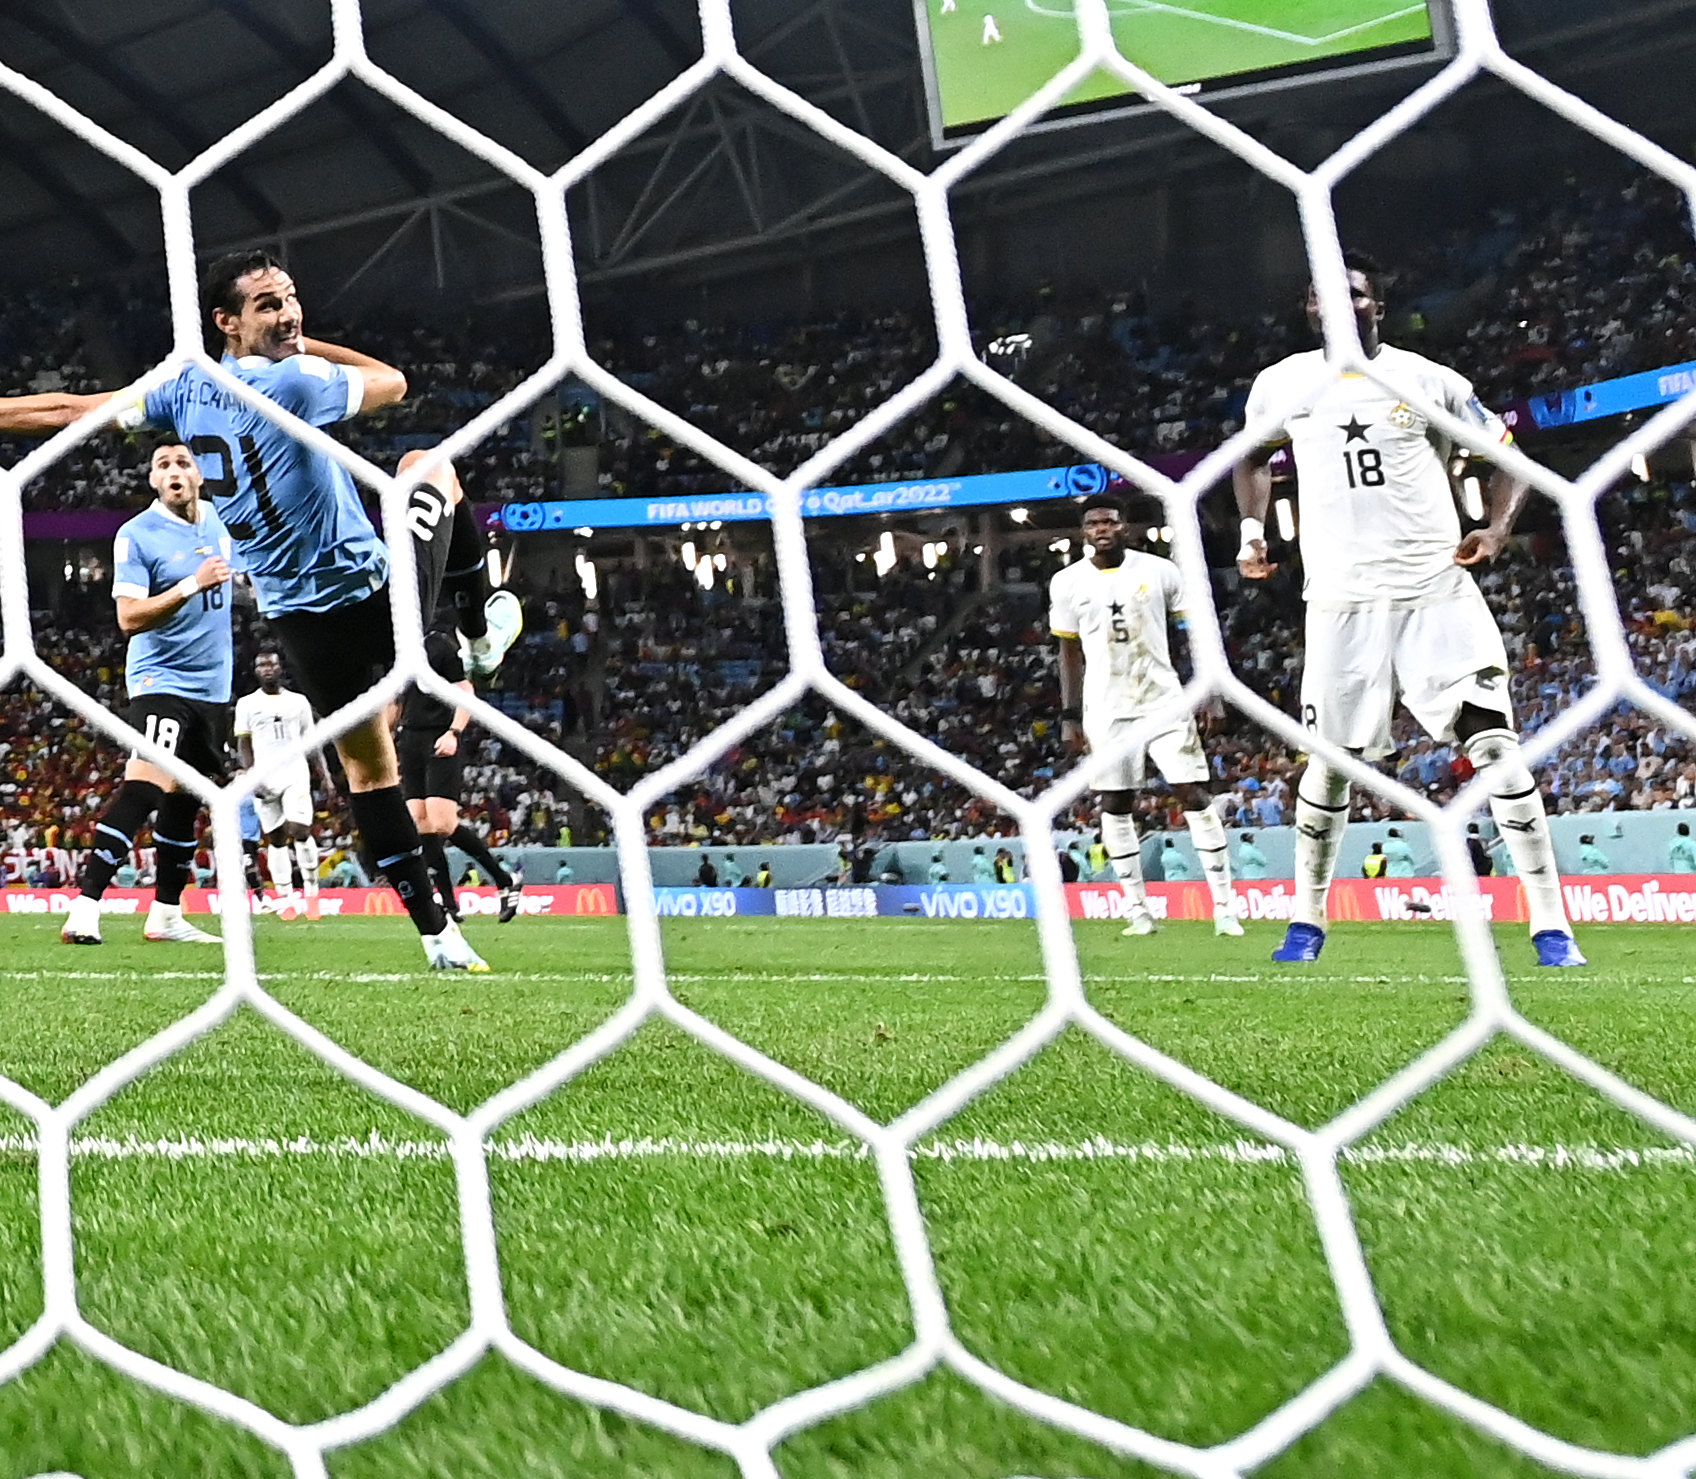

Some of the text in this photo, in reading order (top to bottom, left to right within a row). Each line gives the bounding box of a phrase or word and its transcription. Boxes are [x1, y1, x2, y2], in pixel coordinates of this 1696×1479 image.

[1343, 448, 1385, 489] 18
[188, 434, 287, 540] 21
[647, 501, 690, 519] FIFA
[690, 497, 762, 517] WORLD
[1112, 619, 1130, 643] 5
[145, 714, 180, 757] 18
[6, 893, 48, 912] We
[700, 891, 736, 916] X90
[921, 885, 1026, 918] vivo X90
[1080, 890, 1108, 918] We
[1374, 886, 1413, 920] We
[1563, 884, 1605, 922] We
